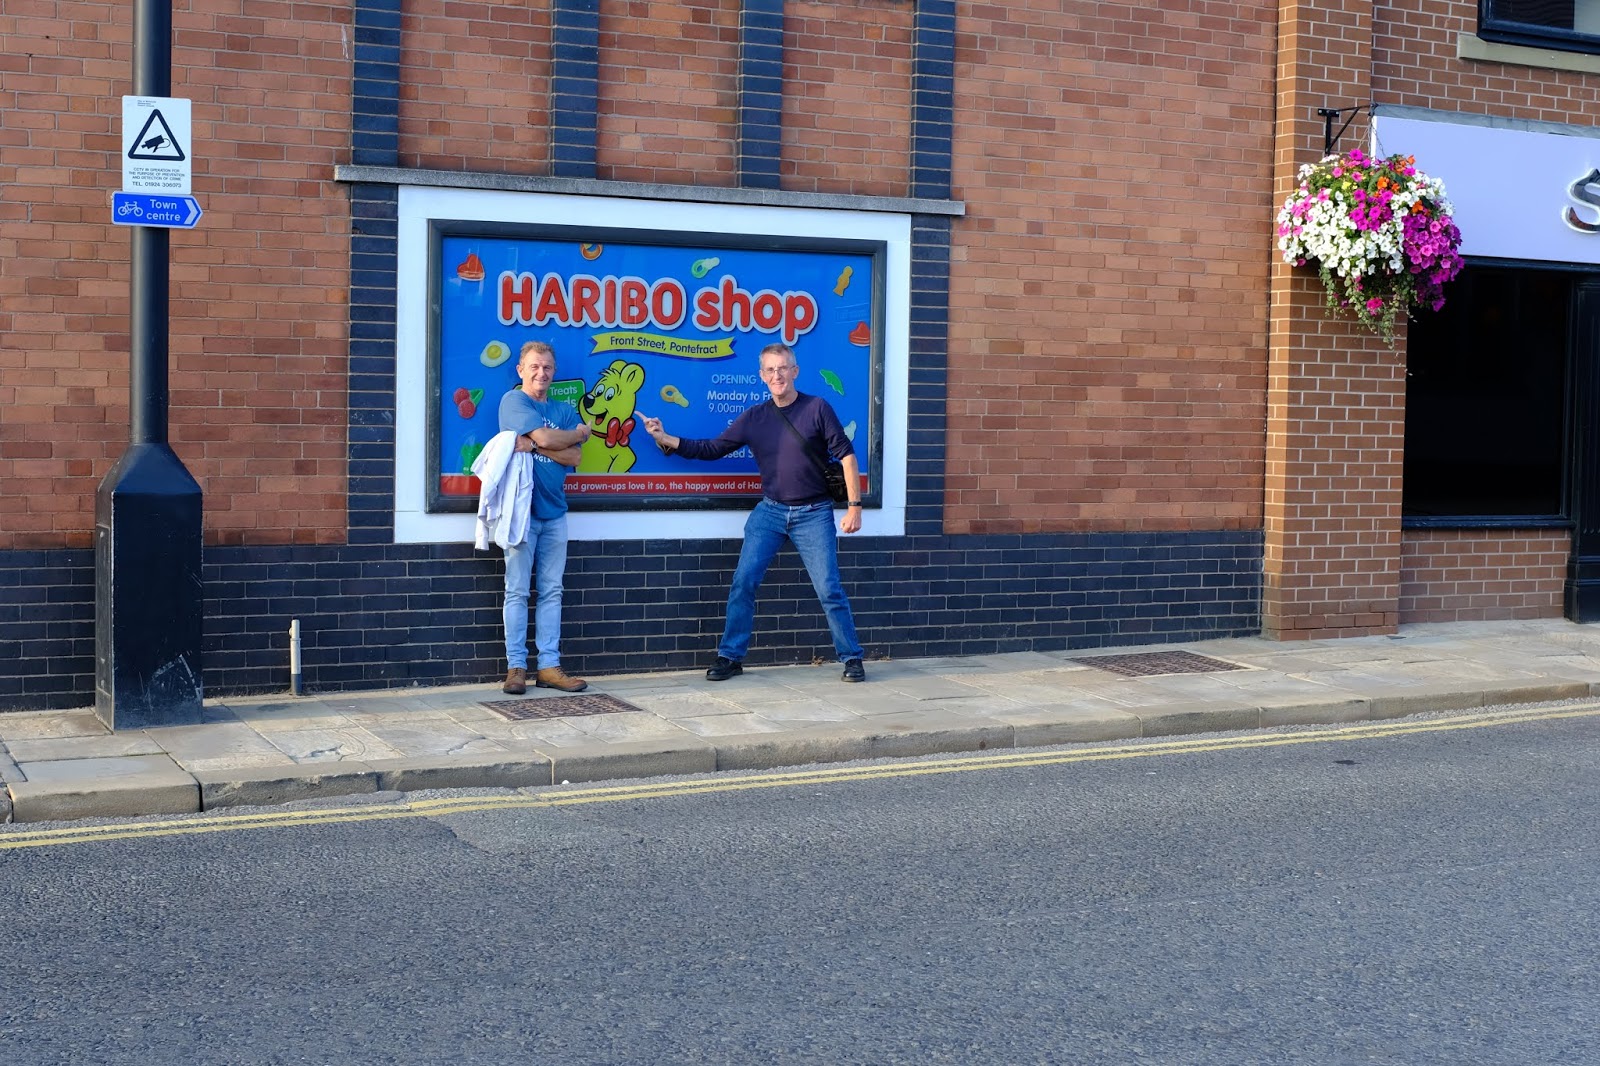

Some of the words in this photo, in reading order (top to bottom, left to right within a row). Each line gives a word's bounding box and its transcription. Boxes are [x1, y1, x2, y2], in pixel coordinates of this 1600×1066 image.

[150, 198, 177, 210] Town
[146, 211, 181, 222] centre
[499, 273, 685, 327] HARIBO
[693, 276, 817, 344] shop
[610, 335, 635, 346] Front
[637, 336, 667, 351] Street,
[669, 341, 718, 354] Pontefract
[711, 373, 757, 385] OPENING
[549, 385, 578, 396] Treats
[706, 390, 748, 403] Monday
[750, 391, 760, 401] to
[762, 391, 773, 401] Fr
[708, 402, 745, 413] 9.00am
[563, 482, 578, 491] and
[581, 482, 627, 492] grown-ups
[628, 481, 645, 490] love
[648, 481, 654, 490] it
[655, 482, 667, 492] so,
[669, 481, 683, 490] the
[685, 481, 710, 492] happy
[712, 481, 735, 490] world
[737, 480, 747, 490] of
[748, 481, 763, 490] Har
